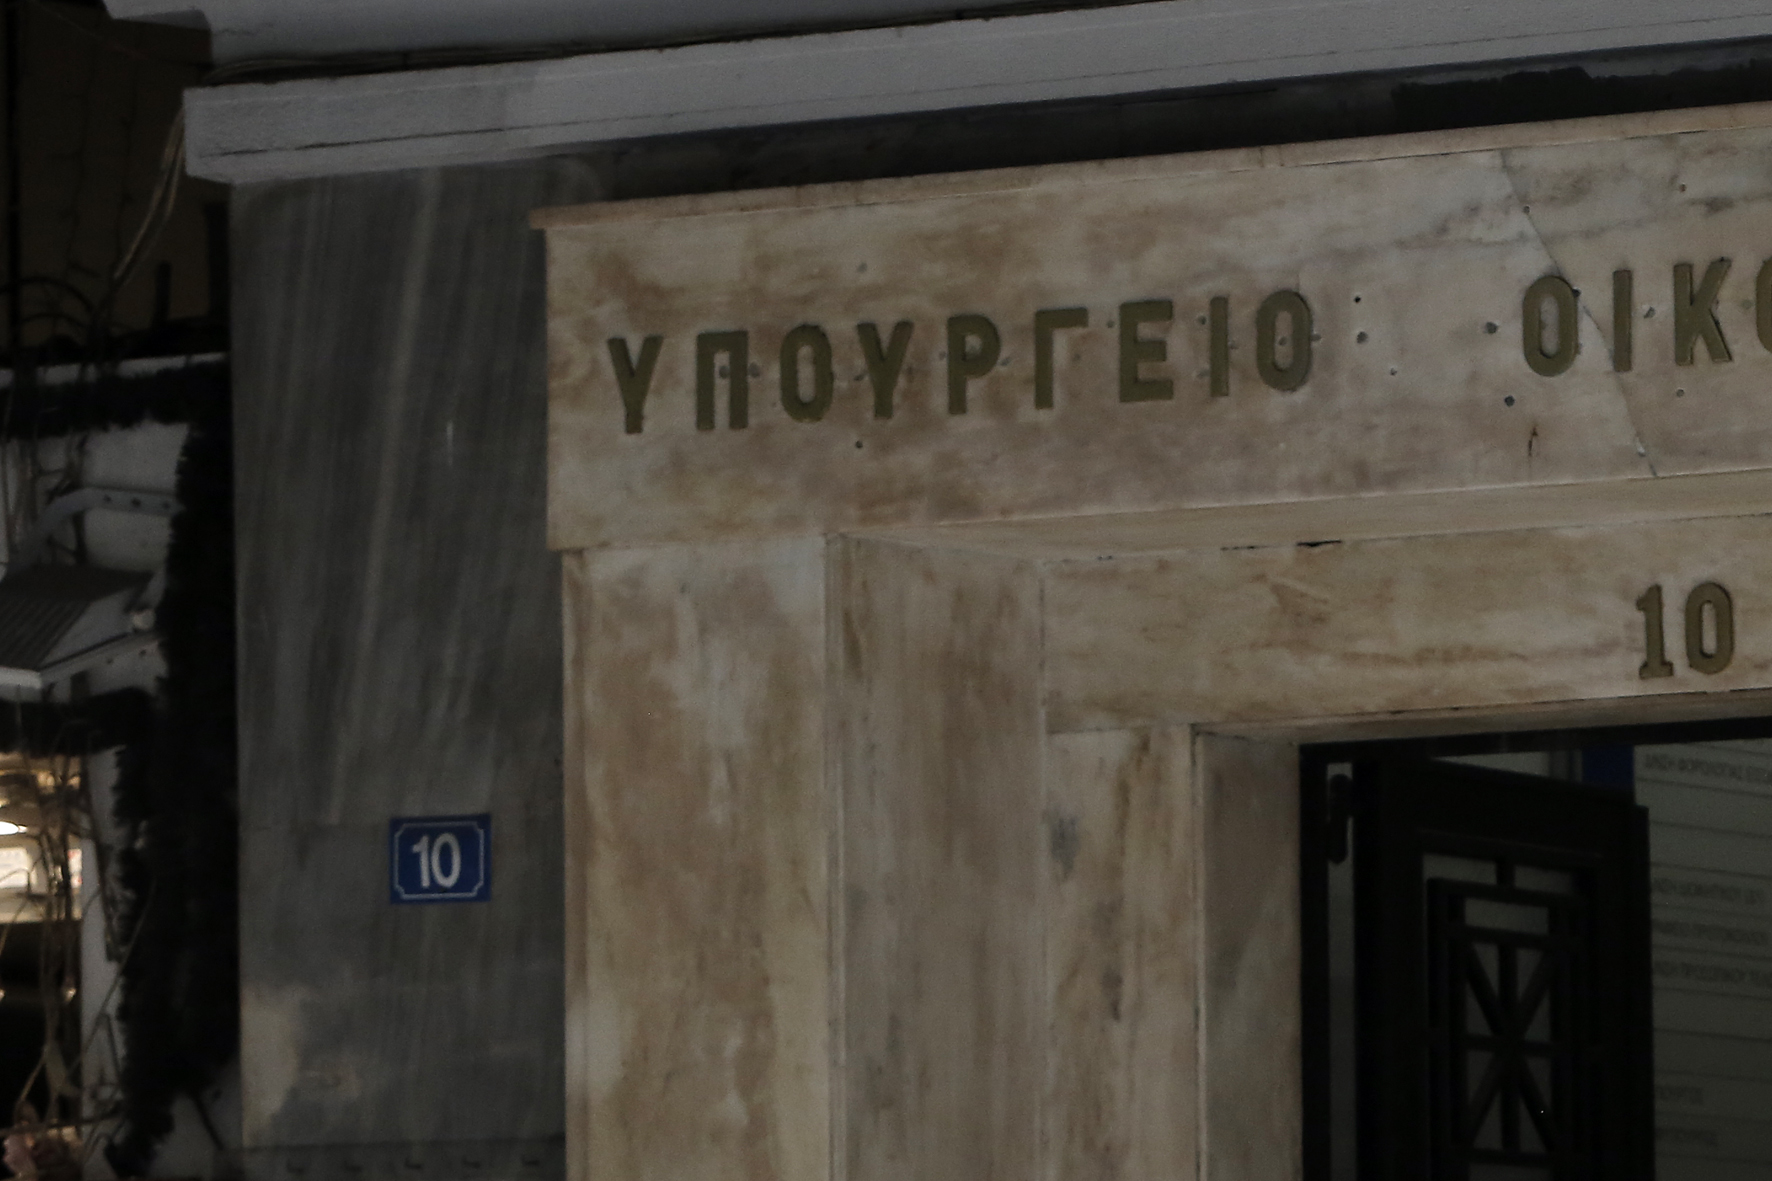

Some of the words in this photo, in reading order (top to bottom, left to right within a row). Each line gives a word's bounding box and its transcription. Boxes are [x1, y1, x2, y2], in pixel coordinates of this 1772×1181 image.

[608, 289, 1314, 434] ΥΠΟΥΡΓΕΙΟ
[1636, 580, 1736, 680] 10
[412, 832, 462, 889] 10
